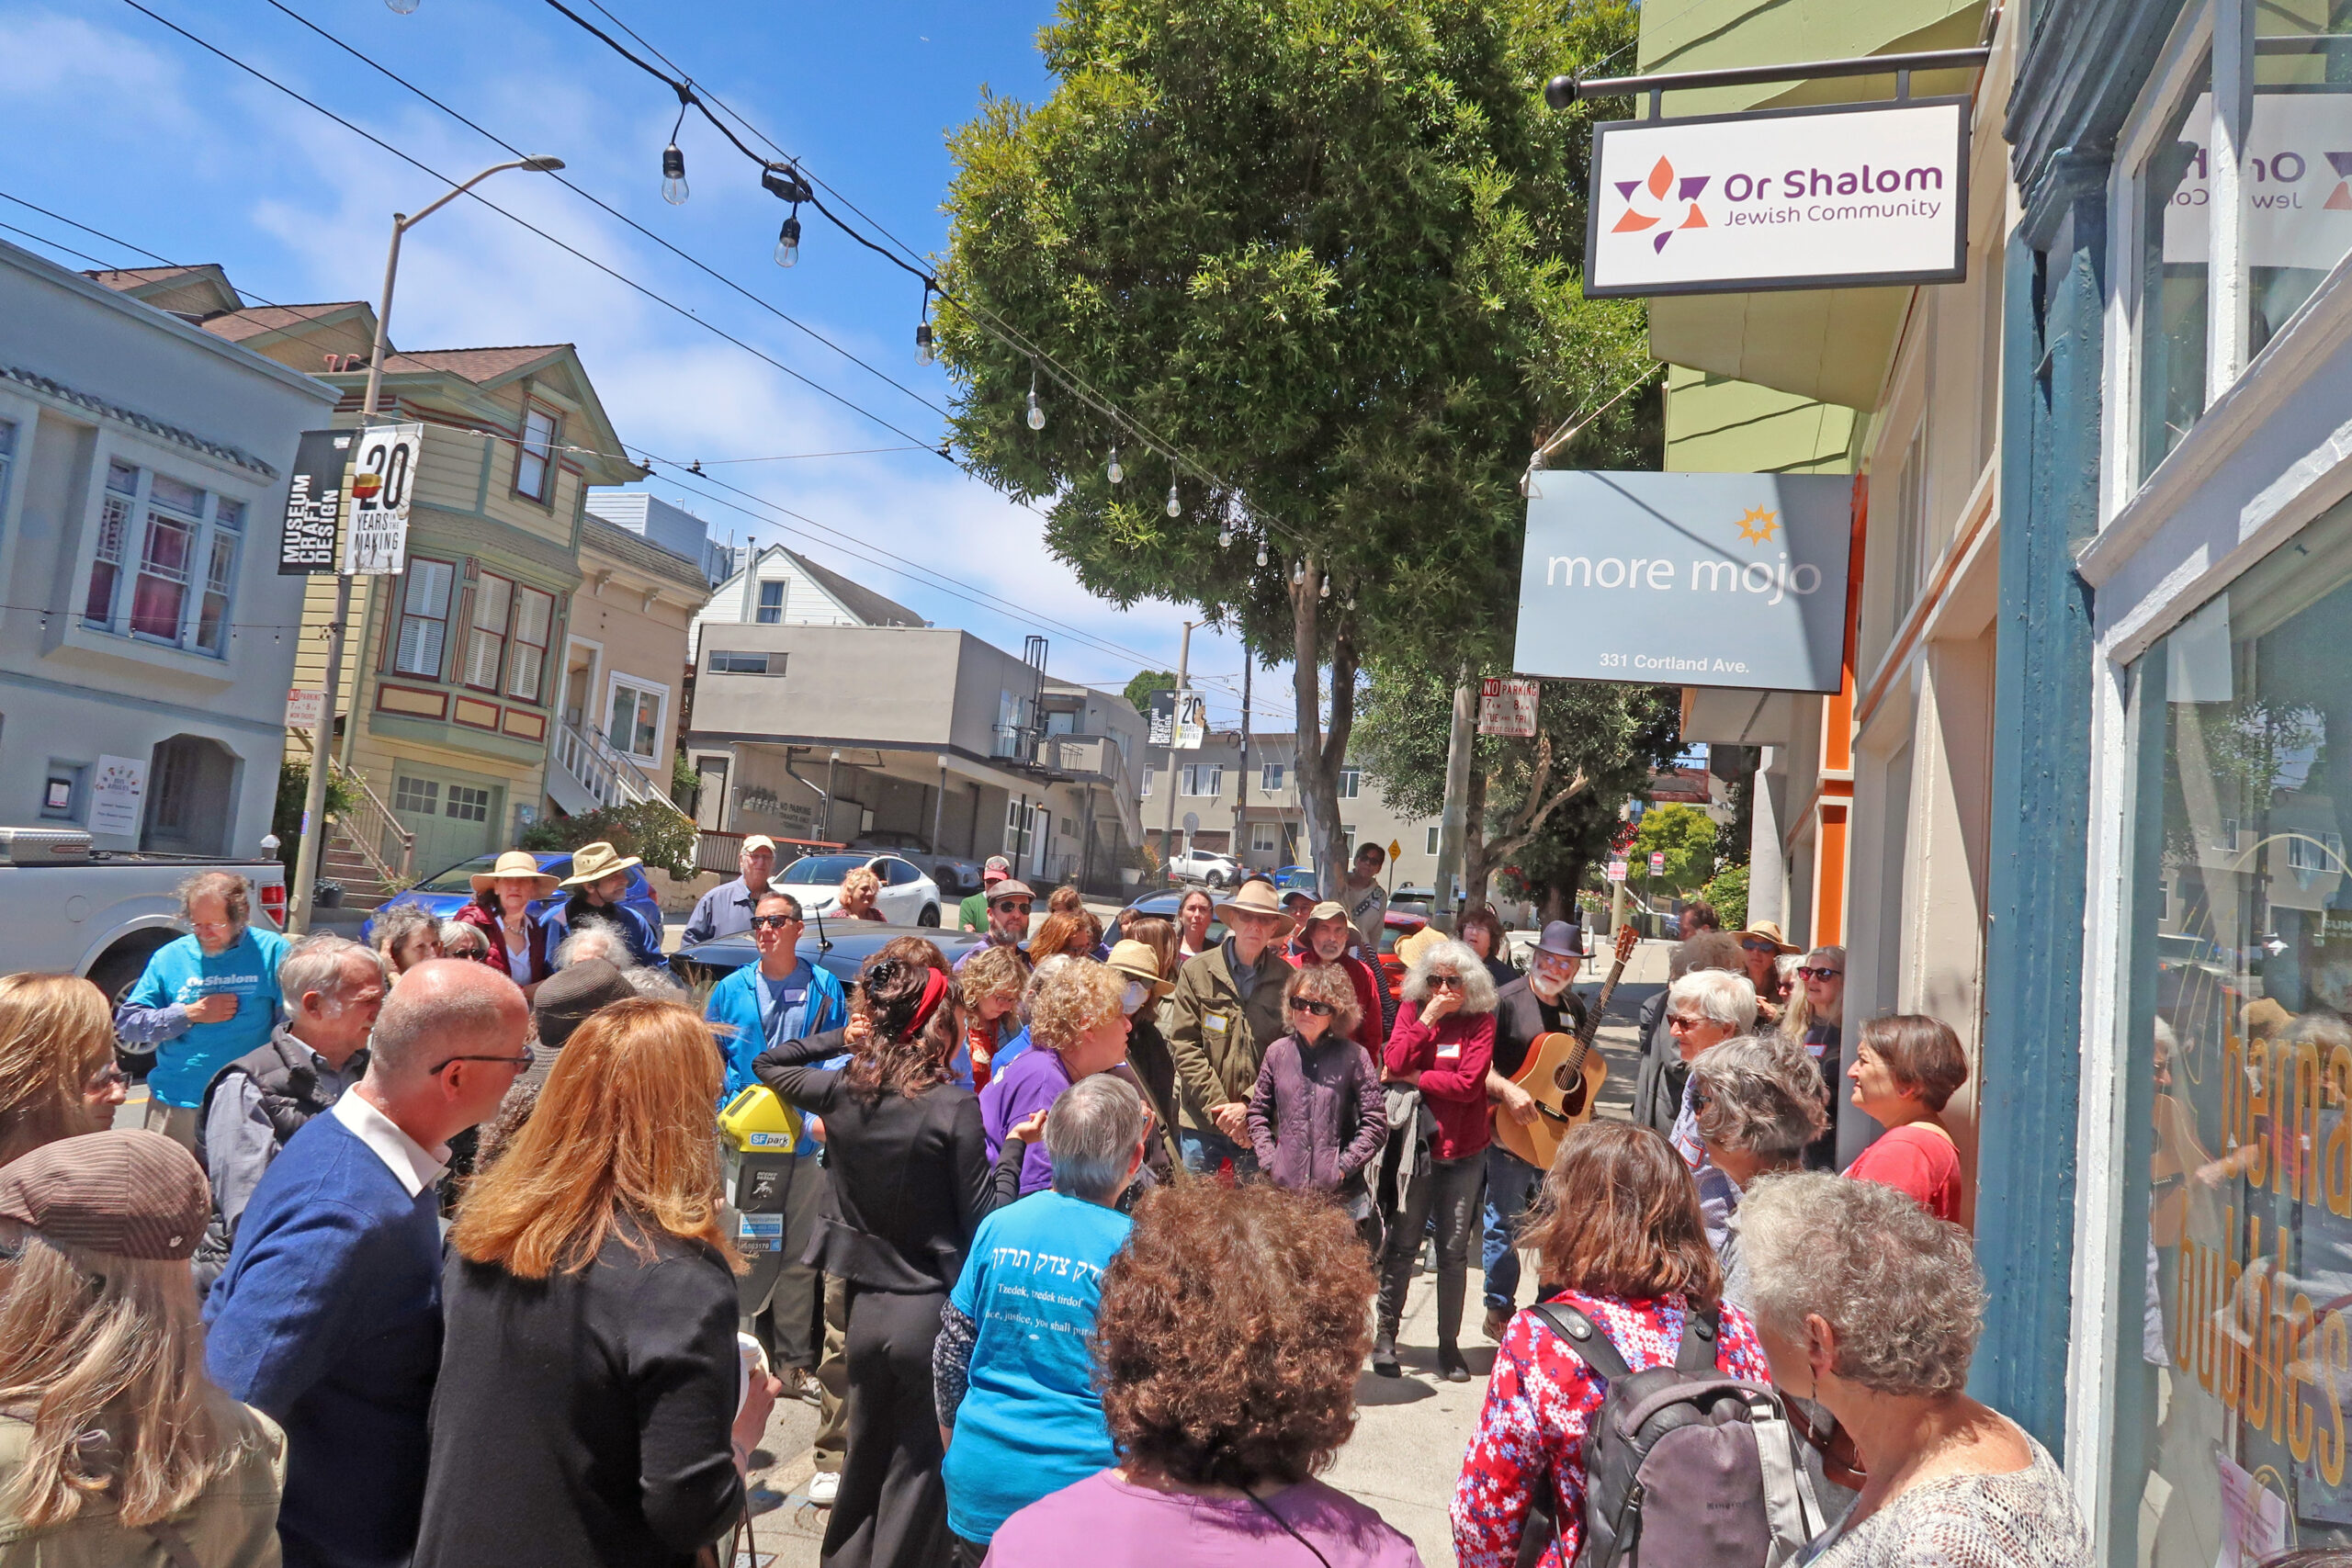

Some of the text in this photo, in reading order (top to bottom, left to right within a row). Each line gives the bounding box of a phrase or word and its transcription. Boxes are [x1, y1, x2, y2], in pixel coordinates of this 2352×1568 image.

[1724, 164, 1942, 202] Or Shalom
[1724, 198, 1941, 226] Jewish Community
[359, 442, 410, 511] 20
[283, 474, 311, 563] MUSEUM
[316, 490, 339, 563] DESIGN
[356, 513, 389, 531] YEARS
[300, 499, 322, 563] CRAFT
[355, 533, 399, 551] MAKING
[1547, 551, 1822, 606] more mojo
[1600, 652, 1749, 673] 331 Cortland Ave.
[289, 690, 300, 700] NO
[1483, 681, 1537, 696] NO PARKING
[1182, 697, 1202, 724] 20
[1487, 713, 1498, 723] TUE
[1515, 715, 1527, 723] FRI
[1148, 707, 1159, 743] MUSEUM
[1156, 719, 1165, 743] CRAFT
[1162, 714, 1172, 743] DESIGN
[1179, 732, 1200, 740] MAKING
[1483, 725, 1502, 733] STREET
[204, 974, 258, 986] Shalom
[1033, 1253, 1071, 1275] צדק
[1072, 1260, 1104, 1283] דק
[998, 1283, 1084, 1308] Tzedek, tzedek tirdof
[1004, 1311, 1033, 1326] justice,
[1035, 1318, 1048, 1328] you
[1050, 1321, 1070, 1333] shall
[2176, 1187, 2347, 1487] bubbles
